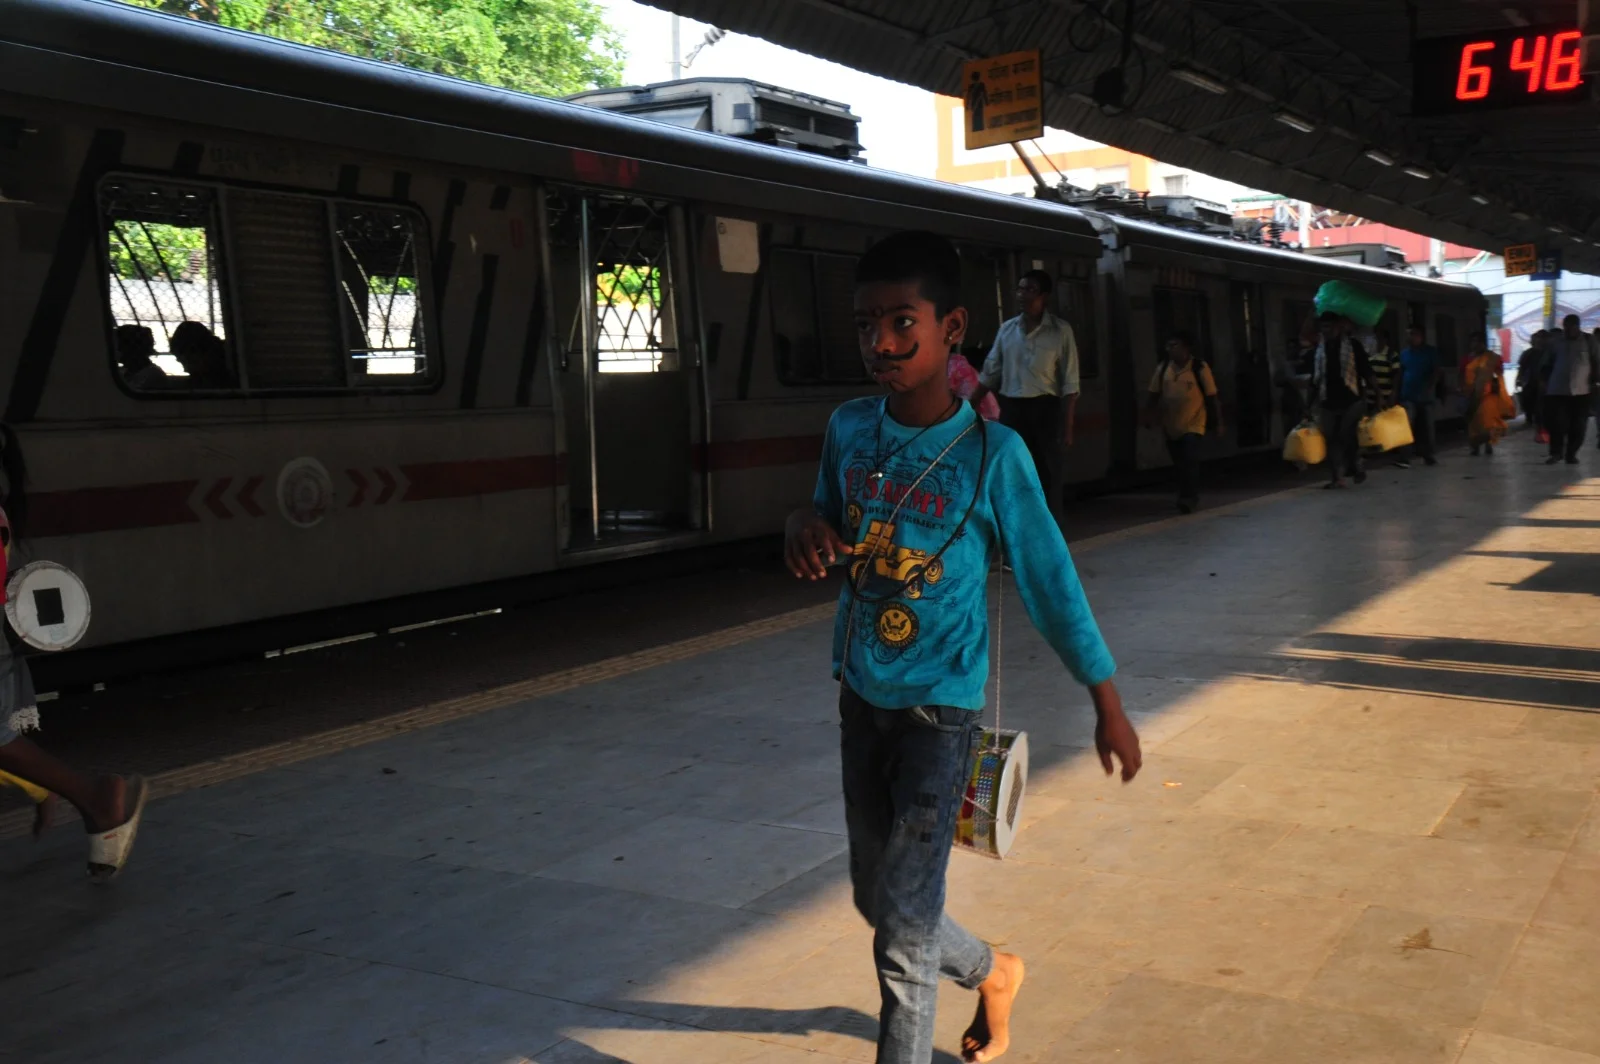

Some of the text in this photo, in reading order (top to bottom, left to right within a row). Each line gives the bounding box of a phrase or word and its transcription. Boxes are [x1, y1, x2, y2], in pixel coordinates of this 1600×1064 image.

[1456, 42, 1495, 100] 6
[1508, 259, 1536, 273] STOP
[1537, 257, 1556, 272] 15
